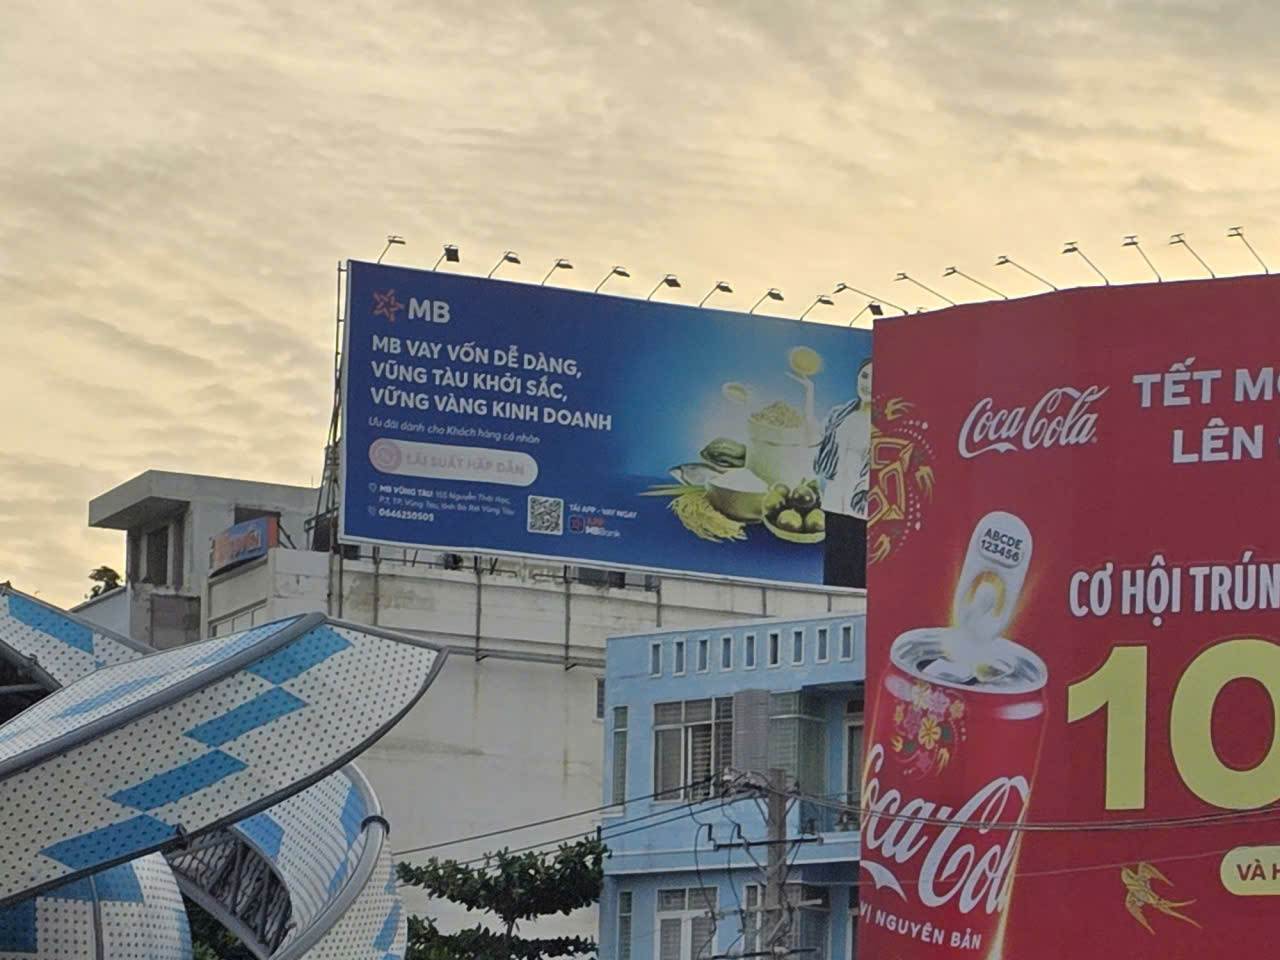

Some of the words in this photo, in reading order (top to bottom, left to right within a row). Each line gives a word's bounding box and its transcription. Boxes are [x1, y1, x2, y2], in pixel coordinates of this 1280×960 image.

[407, 297, 451, 323] MB
[371, 334, 402, 354] MB
[405, 339, 442, 360] VAY
[446, 341, 489, 365] VỐN
[493, 344, 519, 369] DỄ
[523, 352, 582, 379] DÀNG,
[370, 360, 428, 384] VŨNG
[432, 366, 469, 389] TÀU
[473, 372, 522, 394] KHỞI
[525, 375, 568, 402] SẮC,
[1131, 356, 1223, 408] TẾT
[370, 386, 430, 410] VỮNG
[433, 392, 488, 416] VÀNG
[492, 400, 539, 422] KINH
[542, 406, 613, 432] DOANH
[1172, 417, 1264, 464] LÊN
[980, 539, 1020, 563] 123456
[983, 527, 1024, 551] ABCDE
[1067, 563, 1113, 618] CƠ
[1120, 554, 1184, 628] HỘI
[1235, 858, 1267, 882] VÀ
[875, 908, 945, 946] NGUYÊN
[950, 926, 982, 950] BẢN
